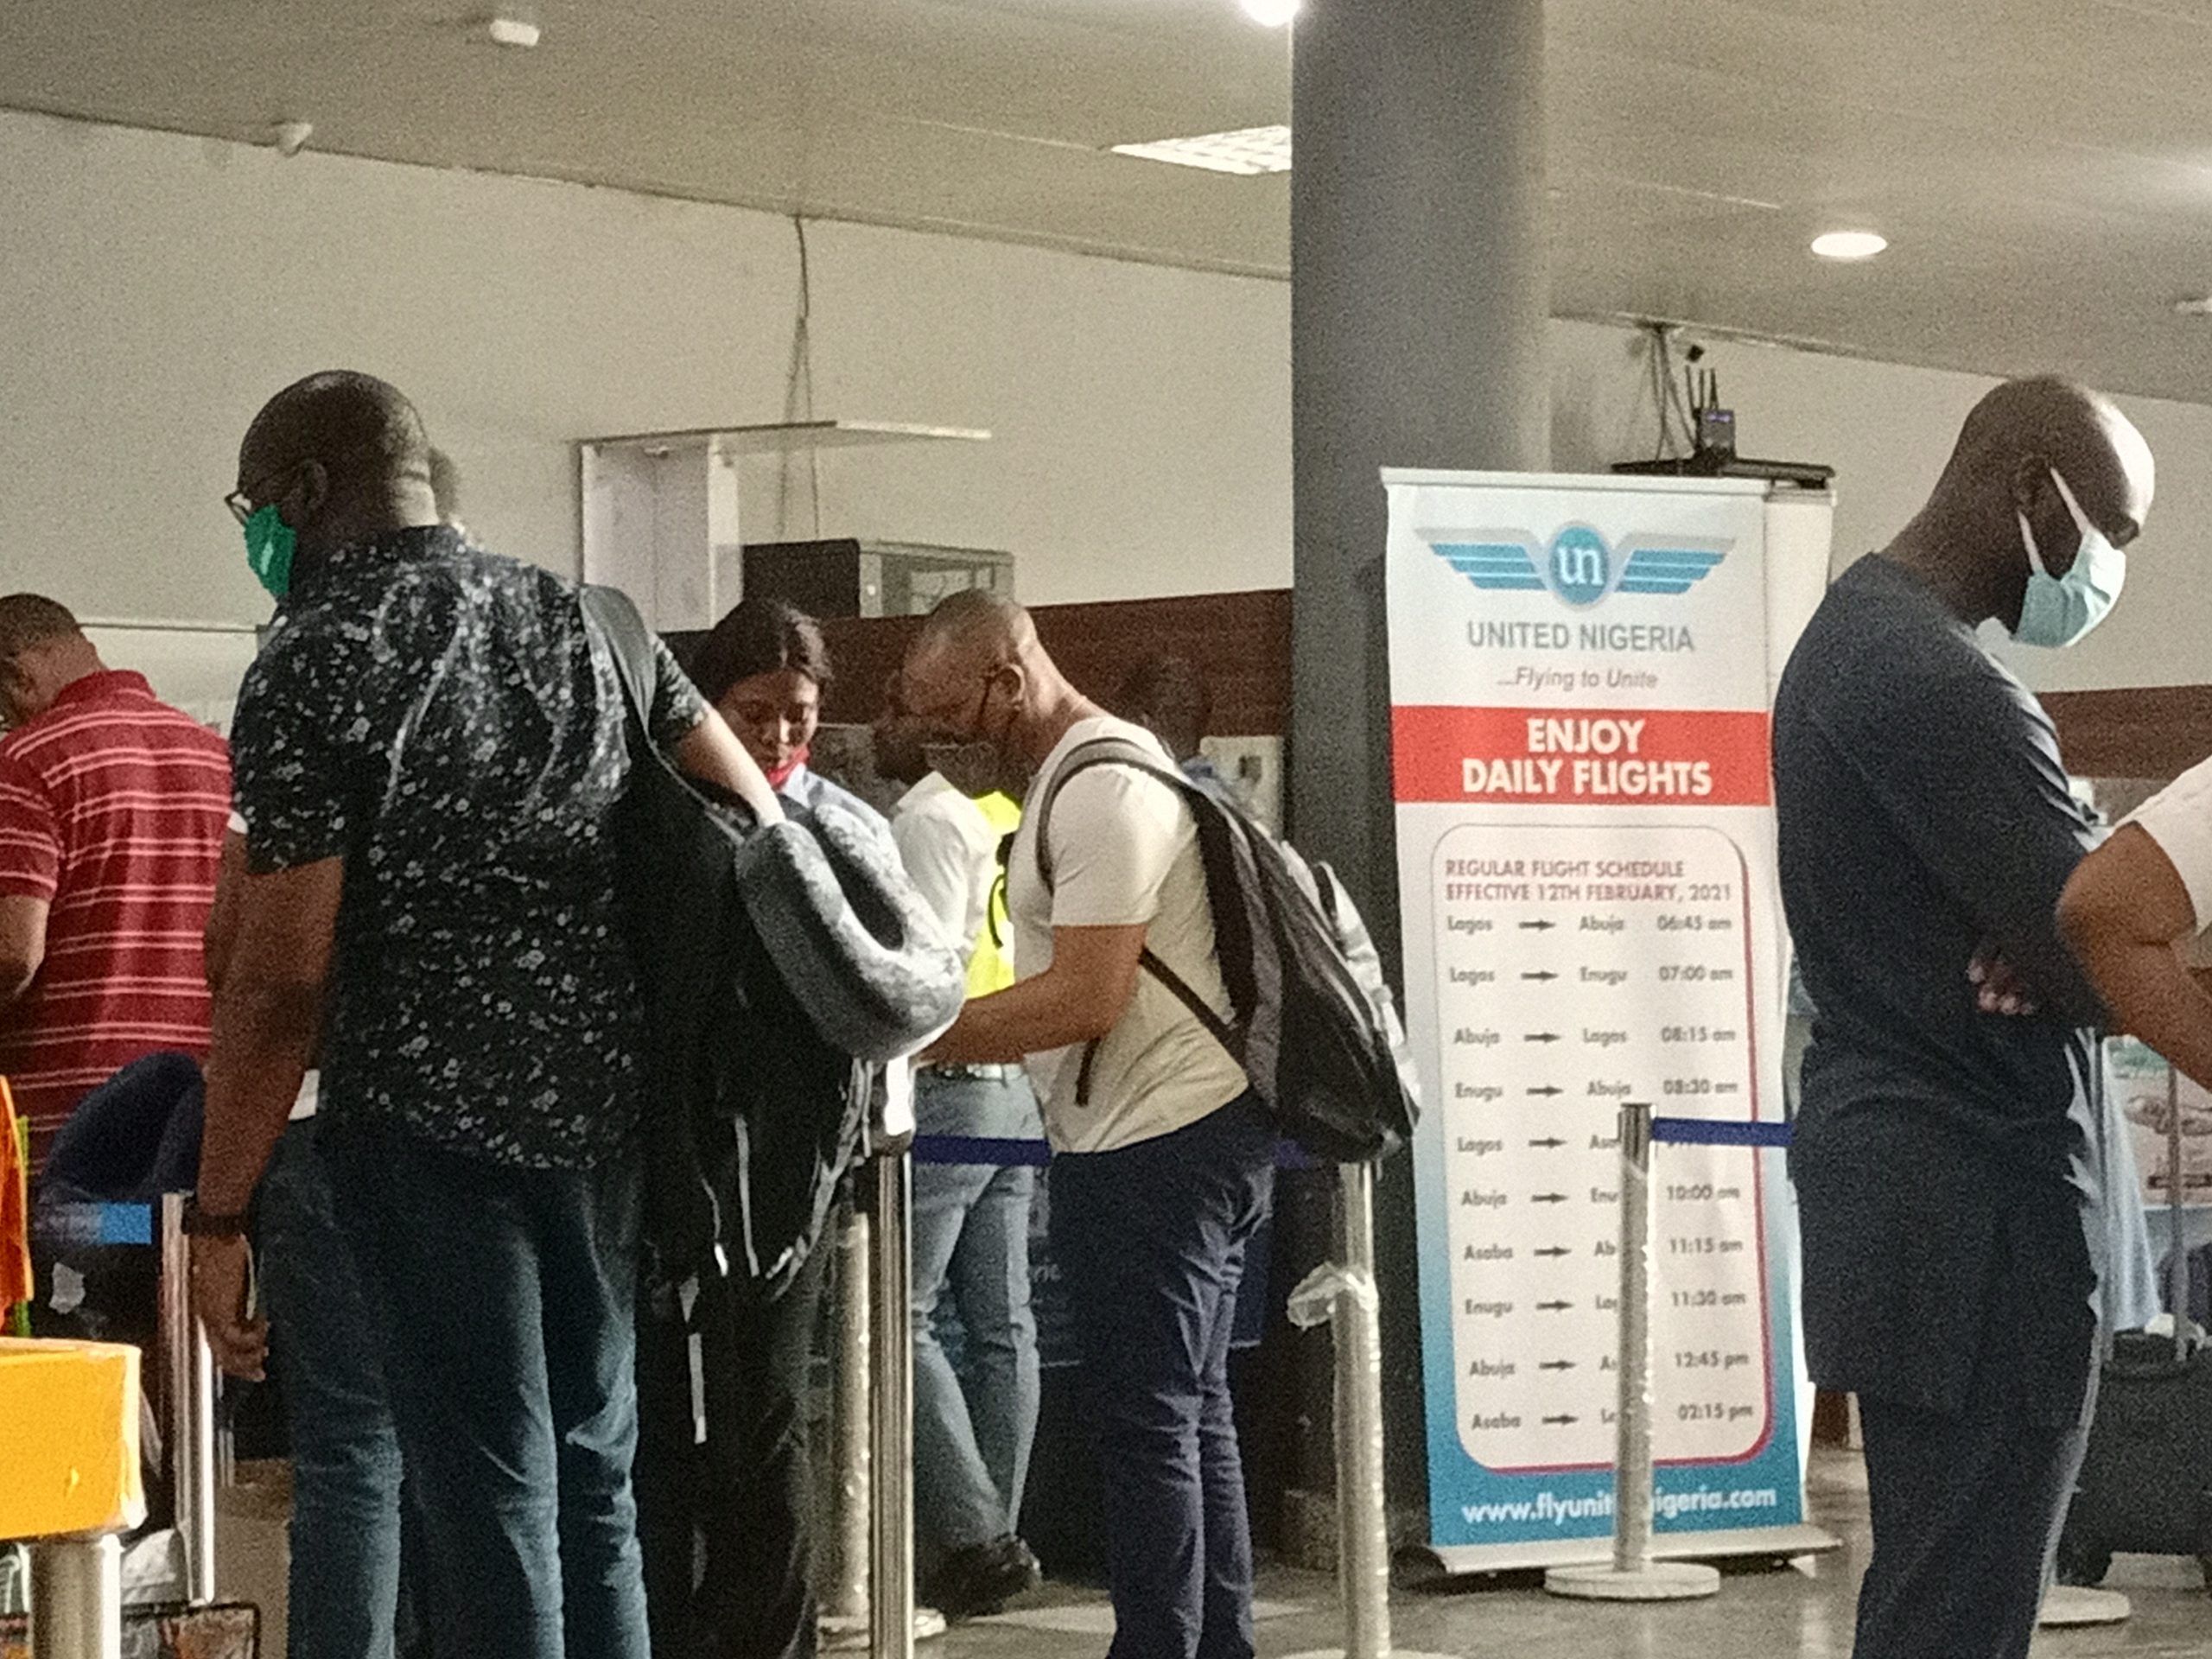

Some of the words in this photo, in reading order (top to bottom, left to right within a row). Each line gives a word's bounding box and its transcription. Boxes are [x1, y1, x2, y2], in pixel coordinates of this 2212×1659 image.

[1467, 621, 1570, 649] UNITED
[1580, 624, 1696, 652] NIGERIA
[1581, 671, 1600, 687] to
[1606, 669, 1658, 688] Unite
[1528, 718, 1644, 753] ENJOY
[1463, 758, 1562, 793] DAILY
[1573, 760, 1712, 795] FLIGHTS
[1446, 859, 1525, 876] REGULAR
[1532, 860, 1590, 877] FLIGHT
[1596, 861, 1683, 878] SCHEDULE
[1446, 883, 1529, 900] EFFECTIVE
[1538, 884, 1580, 901] 12TH
[1587, 883, 1683, 904] FEBRUARY,
[1688, 884, 1730, 901] 2021
[1446, 915, 1493, 935] Lagos
[1580, 915, 1625, 934] Abuja
[1657, 915, 1702, 931] 06:45
[1708, 919, 1732, 930] am
[1449, 967, 1495, 987] Lagos
[1580, 966, 1628, 986] Enugu
[1658, 965, 1705, 982] 07:00
[1710, 969, 1733, 981] am
[1453, 1027, 1500, 1047] Abuja
[1583, 1028, 1628, 1047] Lagos
[1661, 1026, 1707, 1043] 08:15
[1712, 1030, 1736, 1042] am
[1455, 1082, 1503, 1102] Enugu
[1586, 1080, 1631, 1103] Abuja
[1663, 1078, 1709, 1095] 08:30
[1715, 1083, 1738, 1093] am
[1457, 1137, 1503, 1155] Lagos
[1461, 1191, 1507, 1208] Abuja
[1591, 1188, 1617, 1204] Enu
[1668, 1184, 1713, 1200] 10:00
[1717, 1188, 1740, 1198] am
[1464, 1244, 1513, 1260] Asaba
[1670, 1236, 1715, 1254] 11:15
[1718, 1241, 1743, 1253] am
[1465, 1299, 1513, 1318] Enugu
[1673, 1289, 1718, 1306] 11:30
[1720, 1294, 1745, 1306] am
[1469, 1359, 1515, 1378] Abuja
[1675, 1351, 1719, 1368] 12:45
[1724, 1354, 1749, 1370] pm
[1471, 1412, 1521, 1429] Asaba
[1678, 1402, 1725, 1421] 02:15
[1729, 1406, 1753, 1421] pm
